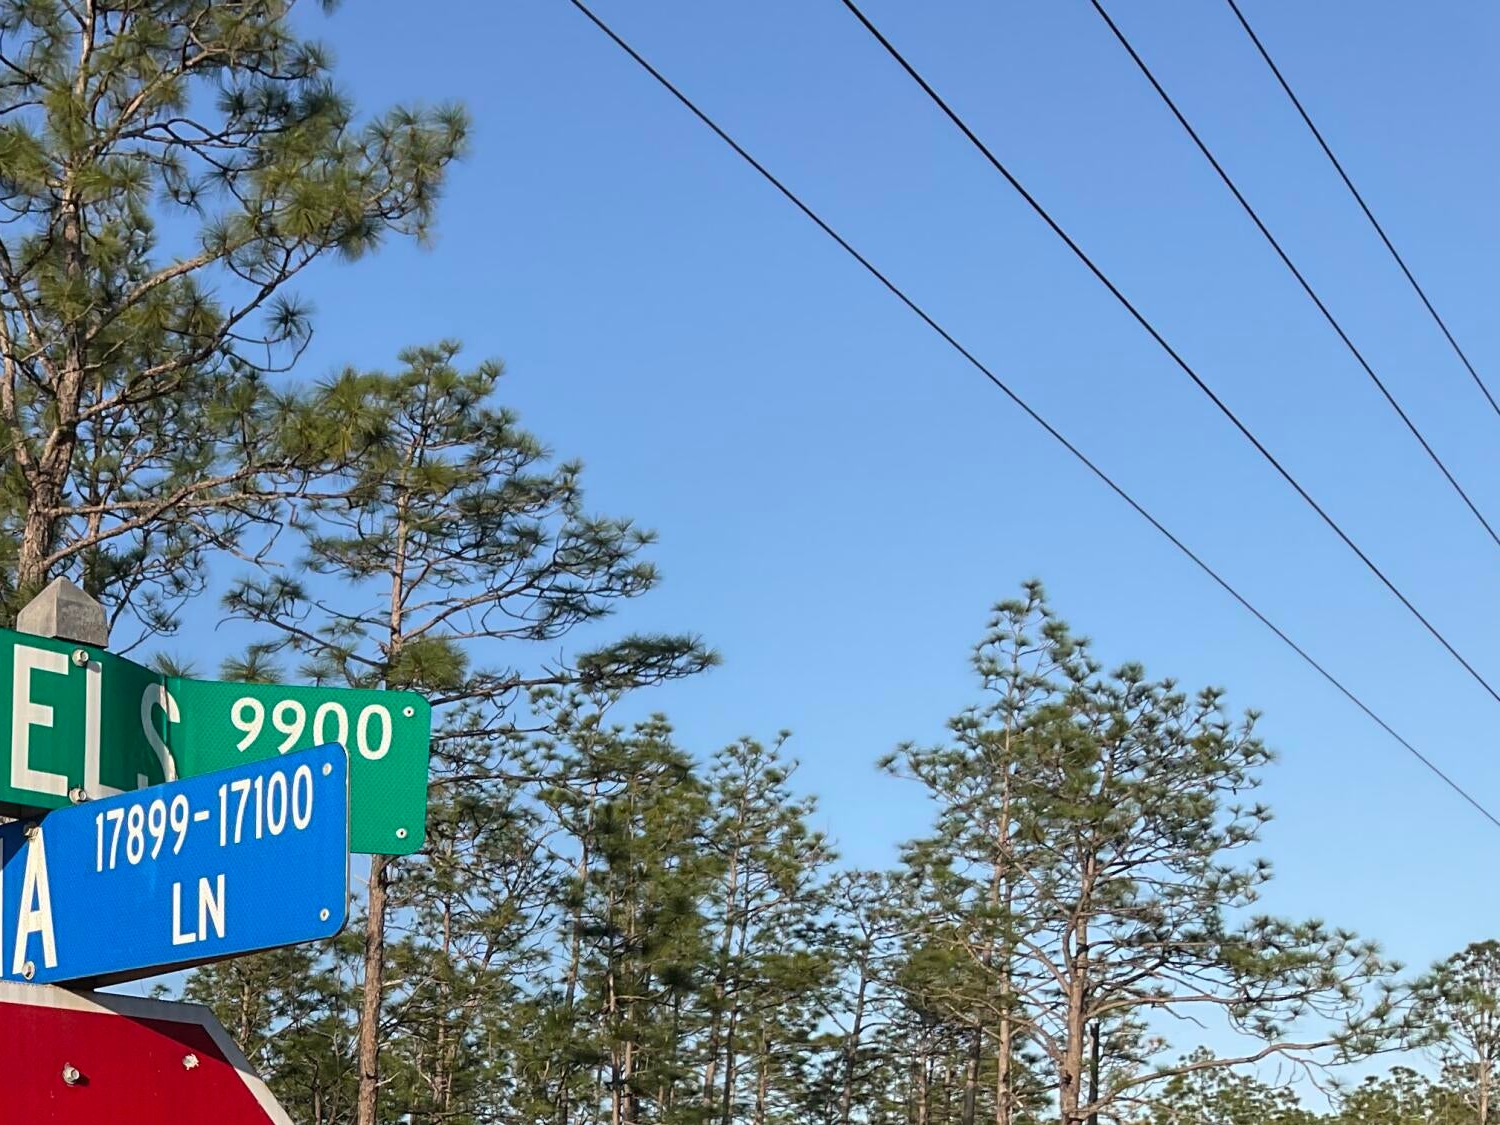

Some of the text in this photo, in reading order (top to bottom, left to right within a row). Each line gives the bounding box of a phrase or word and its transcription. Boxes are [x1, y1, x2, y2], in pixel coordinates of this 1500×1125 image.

[230, 696, 393, 761] 9900
[95, 763, 314, 875] 17899-17100
[171, 873, 227, 946] LN
